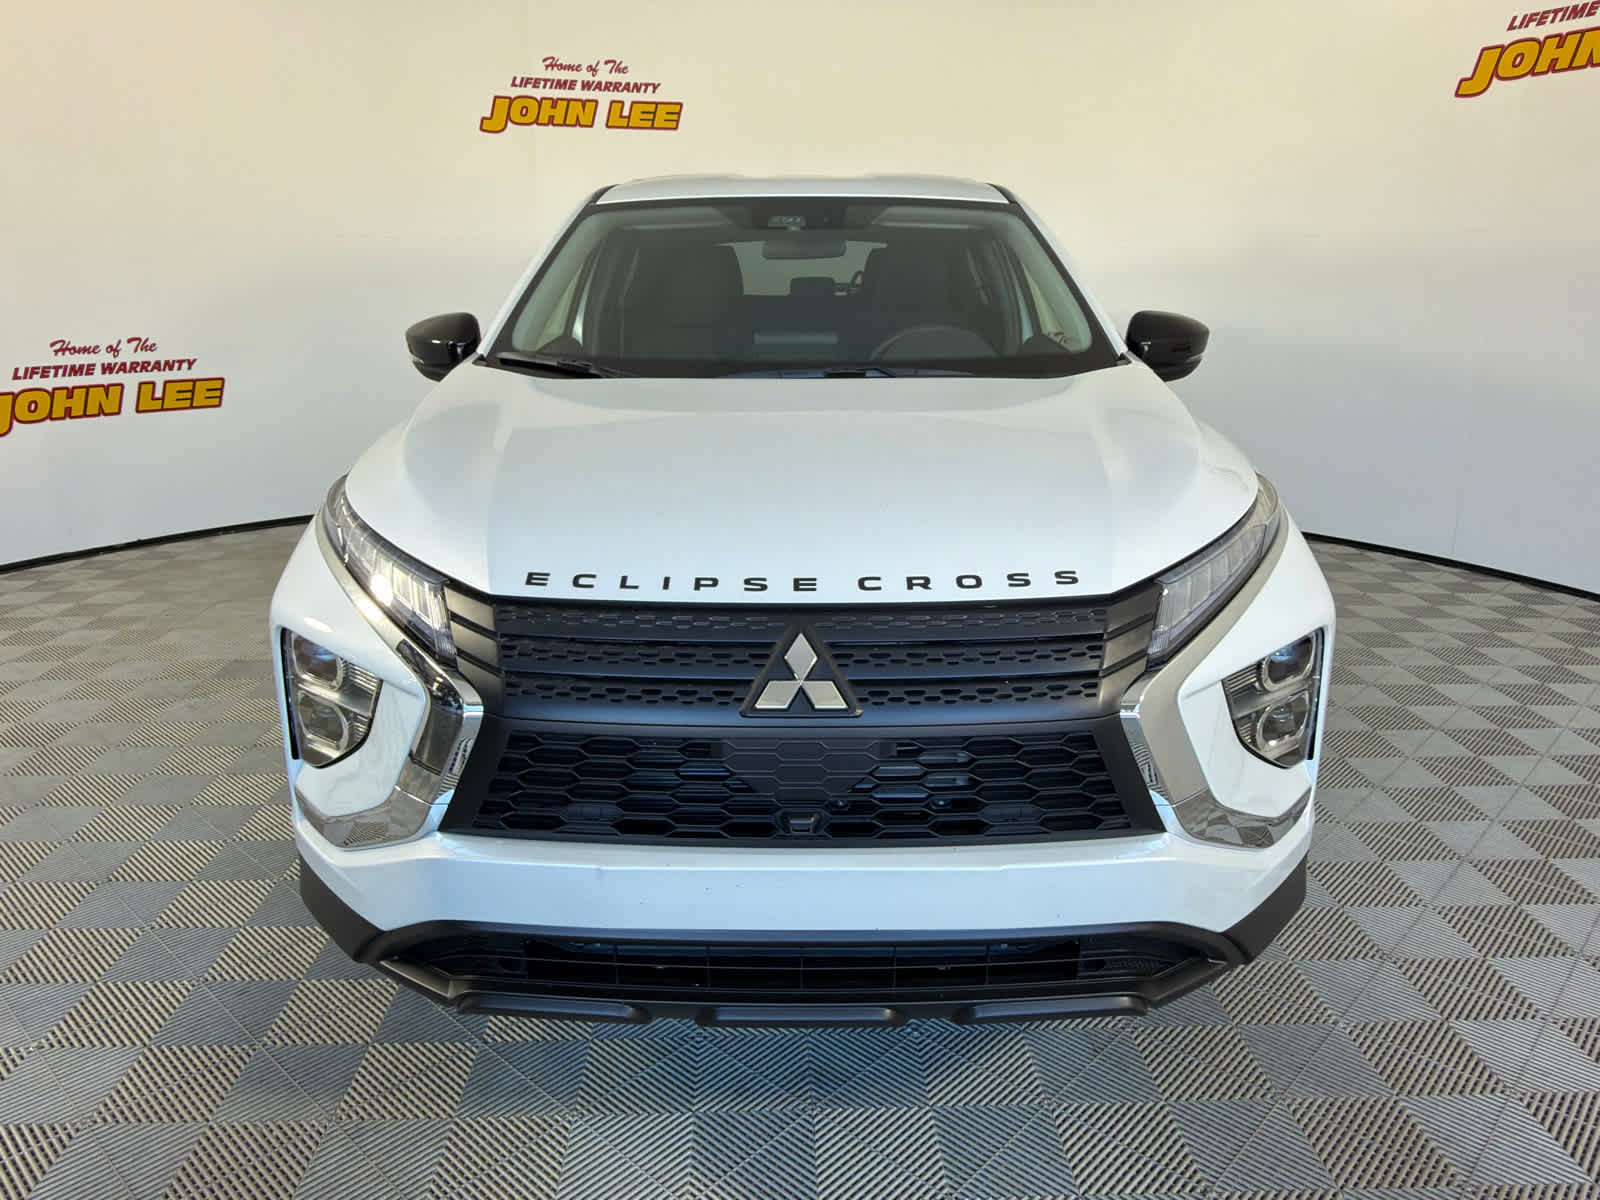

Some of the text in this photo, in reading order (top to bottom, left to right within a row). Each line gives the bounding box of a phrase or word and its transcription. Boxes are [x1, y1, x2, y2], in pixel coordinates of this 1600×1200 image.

[1507, 0, 1600, 31] LIFETIME
[542, 56, 629, 77] Home of The
[511, 76, 661, 94] LIFETIME WARRANTY
[480, 95, 683, 133] JOHN LEE
[49, 337, 157, 358] Home of The
[12, 358, 197, 380] LIFETIME WARRANTY
[135, 377, 225, 413] LEE
[525, 570, 1079, 592] ECLIPSE CROSS
